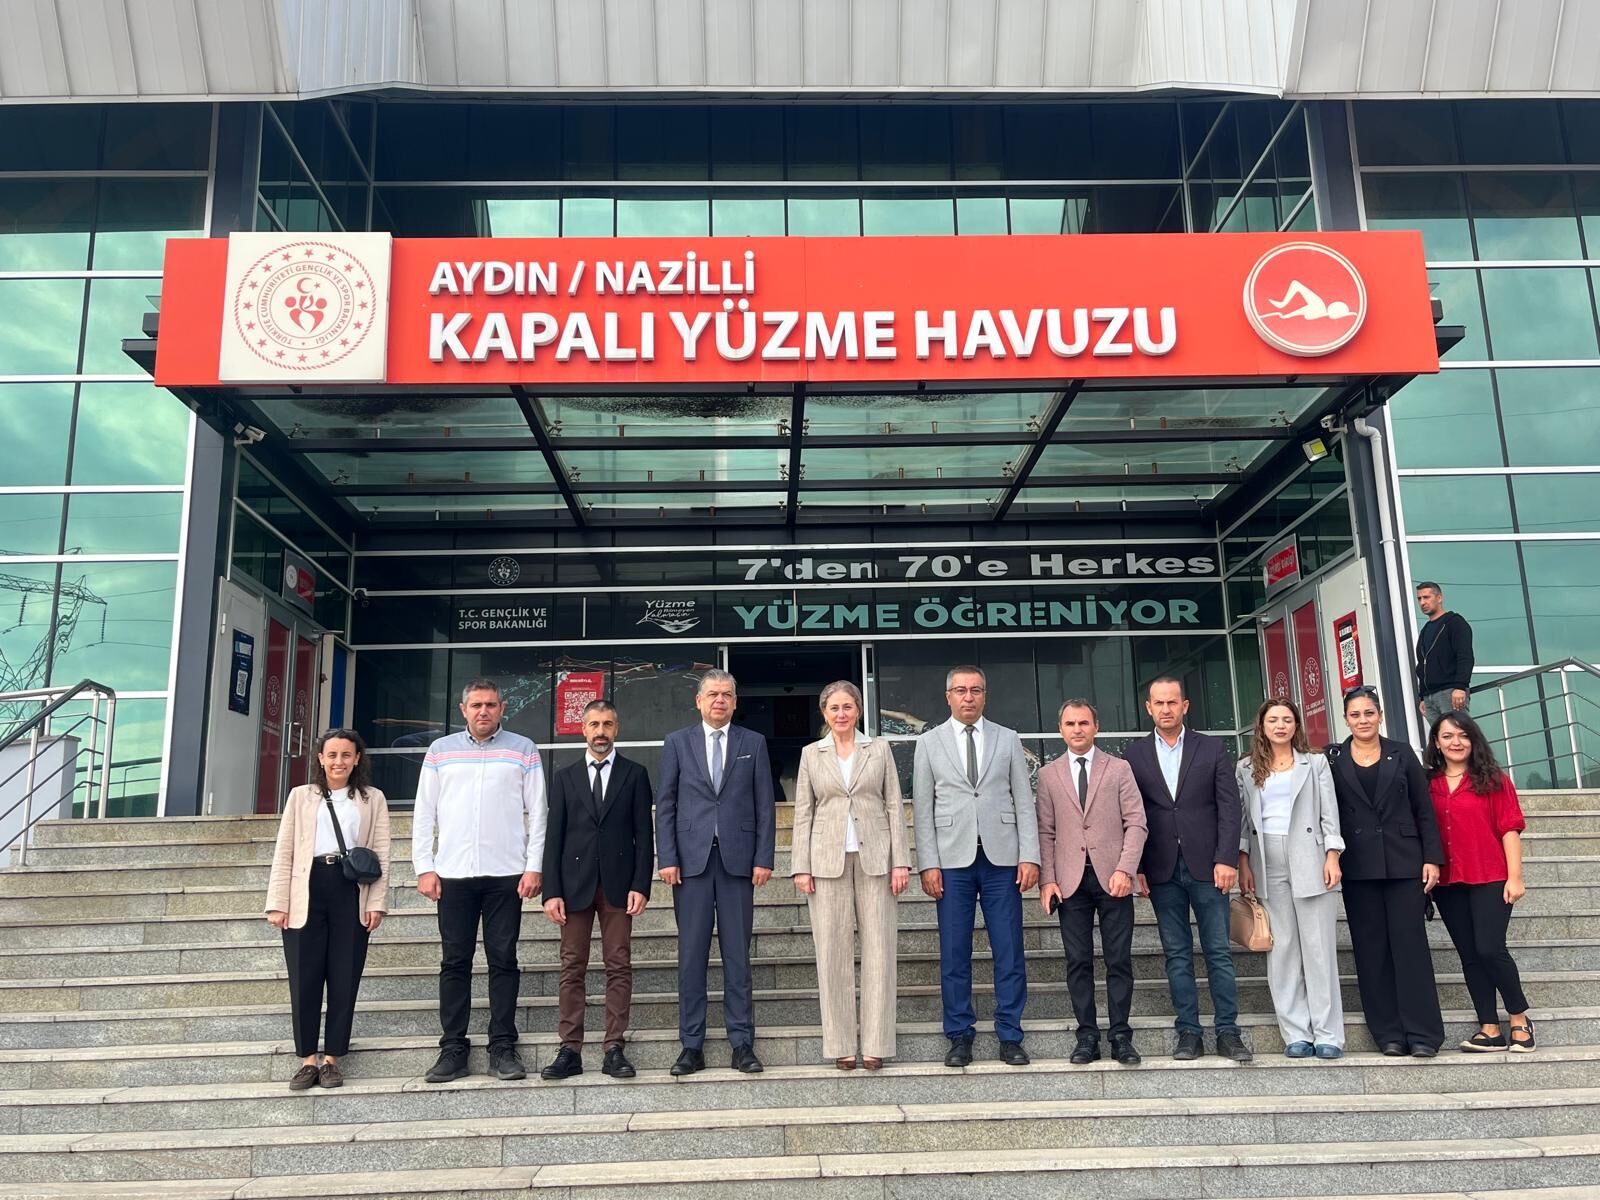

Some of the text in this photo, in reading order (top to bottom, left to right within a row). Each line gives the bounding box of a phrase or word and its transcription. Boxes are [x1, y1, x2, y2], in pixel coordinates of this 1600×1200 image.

[428, 250, 755, 297] AYDIN / NAZİLLİ
[428, 298, 1178, 363] KAPALI YÜZME HAVUZU
[737, 552, 1215, 581] 7'den 70'e Herkes
[459, 607, 547, 620] T.C. GENÇLİK VE
[645, 599, 696, 609] Yüzme
[732, 595, 1200, 630] YÜZME ÖĞRENİYOR
[458, 617, 547, 630] SPOR BAKANLIĞI
